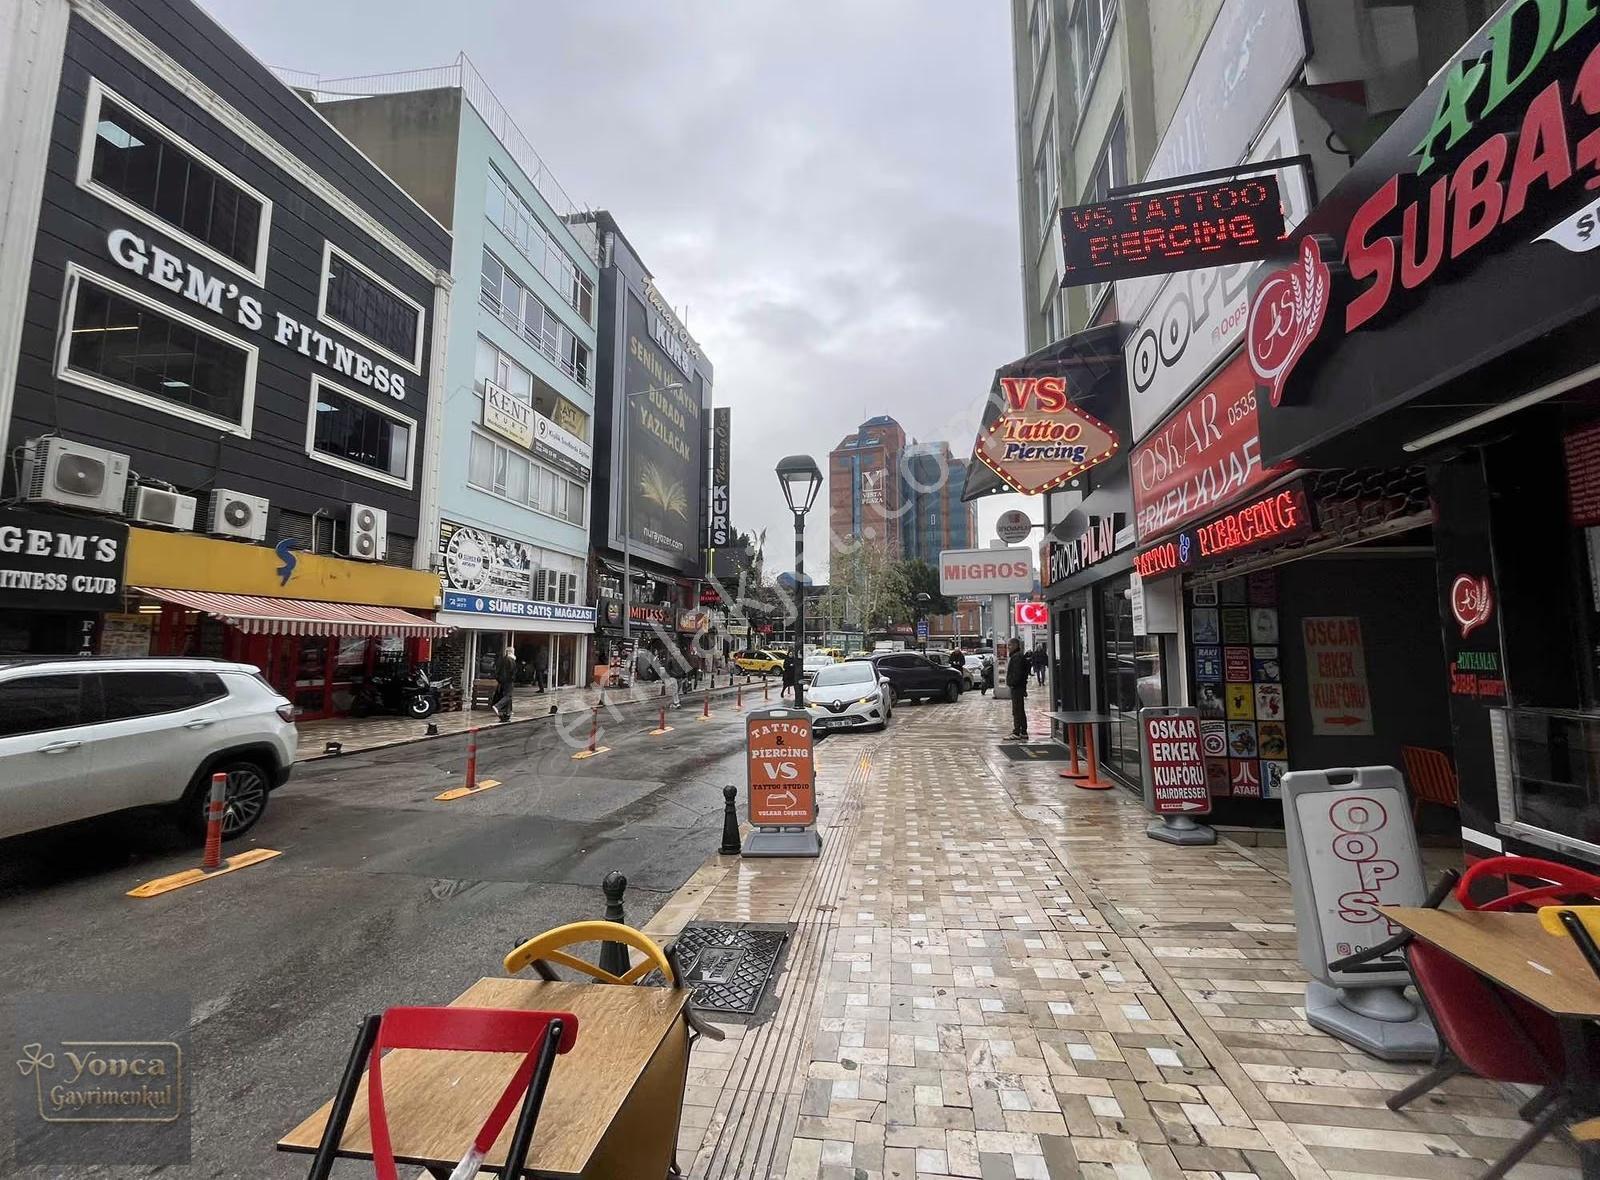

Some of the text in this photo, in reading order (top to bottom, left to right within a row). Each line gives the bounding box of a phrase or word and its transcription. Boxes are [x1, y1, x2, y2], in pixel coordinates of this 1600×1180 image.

[1408, 0, 1597, 175] AD
[1072, 183, 1267, 231] VS TATTOO
[1089, 214, 1257, 260] PIERCING
[276, 311, 406, 401] FITNESS
[489, 386, 530, 426] KENT
[1000, 376, 1067, 413] VS
[1228, 390, 1257, 426] 0535
[539, 421, 546, 435] 9
[641, 405, 690, 462] YAZILACAK
[1002, 417, 1082, 442] Tattoo
[1003, 442, 1088, 465] Piercing
[1134, 392, 1223, 492] OSKAR
[714, 485, 727, 546] KURS
[1134, 490, 1298, 577] TATTOO & PIERCING
[72, 574, 117, 596] CLUB
[488, 598, 593, 620] SÜMER SATIŞ MAĞAZASI
[752, 723, 808, 739] TATTOO
[776, 735, 785, 746] &
[1149, 720, 1197, 739] OSKAR
[1152, 742, 1200, 761] ERKEK
[763, 761, 798, 780] VS
[1154, 761, 1204, 786] KUAFÖRÜ
[1156, 787, 1207, 799] HAIRDRESSER
[1233, 785, 1260, 796] ATARI
